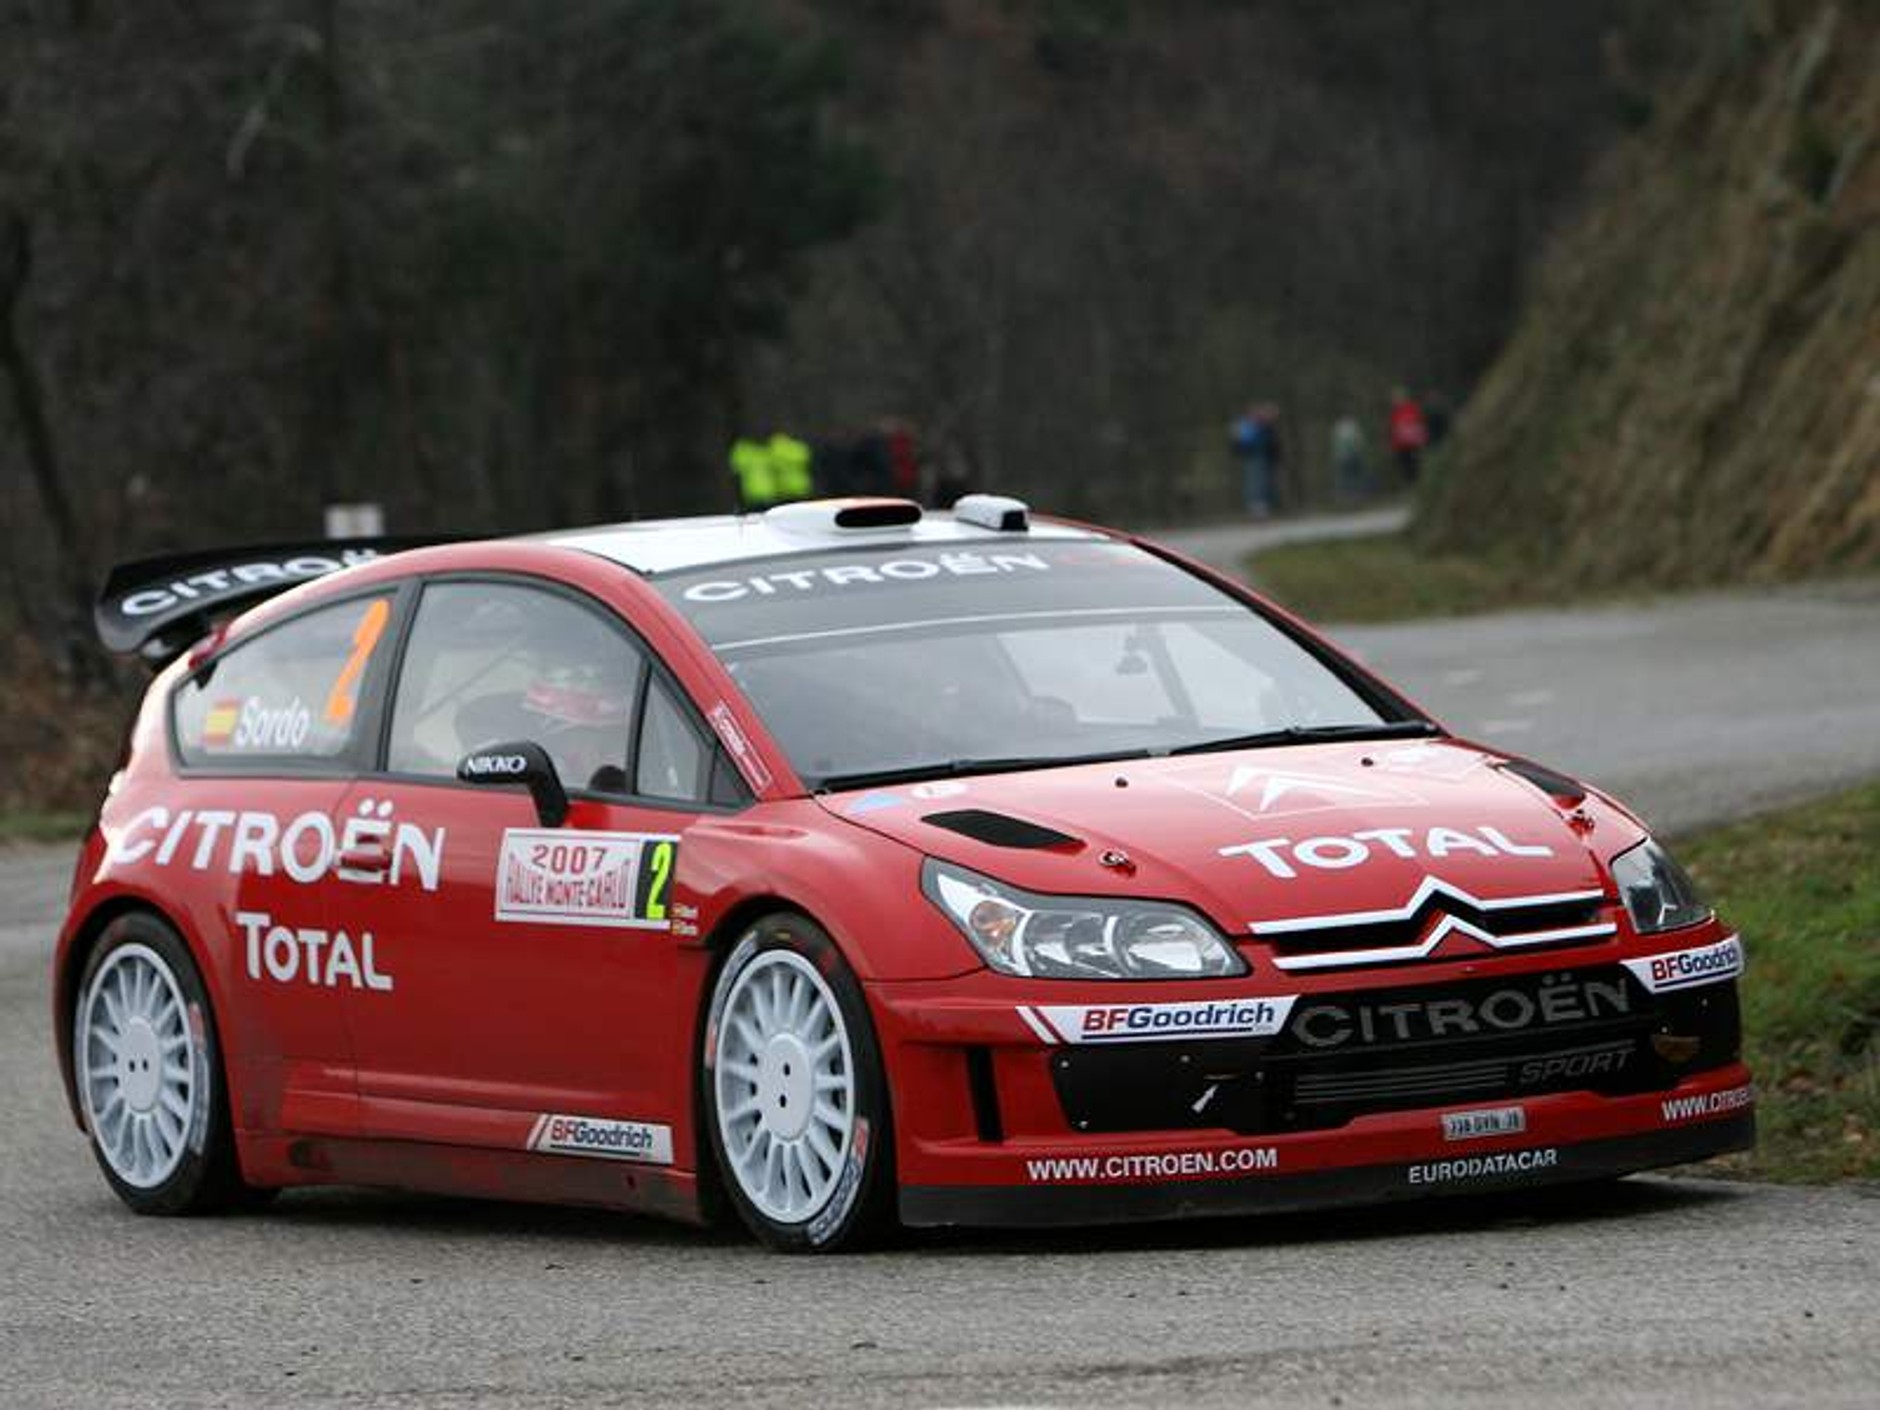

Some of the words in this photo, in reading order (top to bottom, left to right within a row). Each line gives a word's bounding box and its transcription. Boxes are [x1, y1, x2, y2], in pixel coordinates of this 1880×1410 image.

[683, 553, 1051, 602] CITROËN
[324, 598, 390, 728] 2
[234, 697, 310, 748] Sordo
[465, 754, 528, 776] NIKKO
[104, 799, 446, 891] CITROËN
[532, 844, 607, 874] 2007
[1219, 826, 1554, 879] TOTAL
[647, 842, 672, 919] 2
[235, 911, 393, 991] TOTAL
[1653, 944, 1740, 980] BFGoodrich
[1082, 1002, 1275, 1031] BFGoodrich
[1292, 973, 1632, 1047] CITROËN
[1519, 1050, 1636, 1084] SPORT
[551, 1119, 652, 1147] BFGoodrich
[1027, 1148, 1278, 1181] WWW.CITROEN.COM
[1409, 1149, 1558, 1184] EURODATACAR
